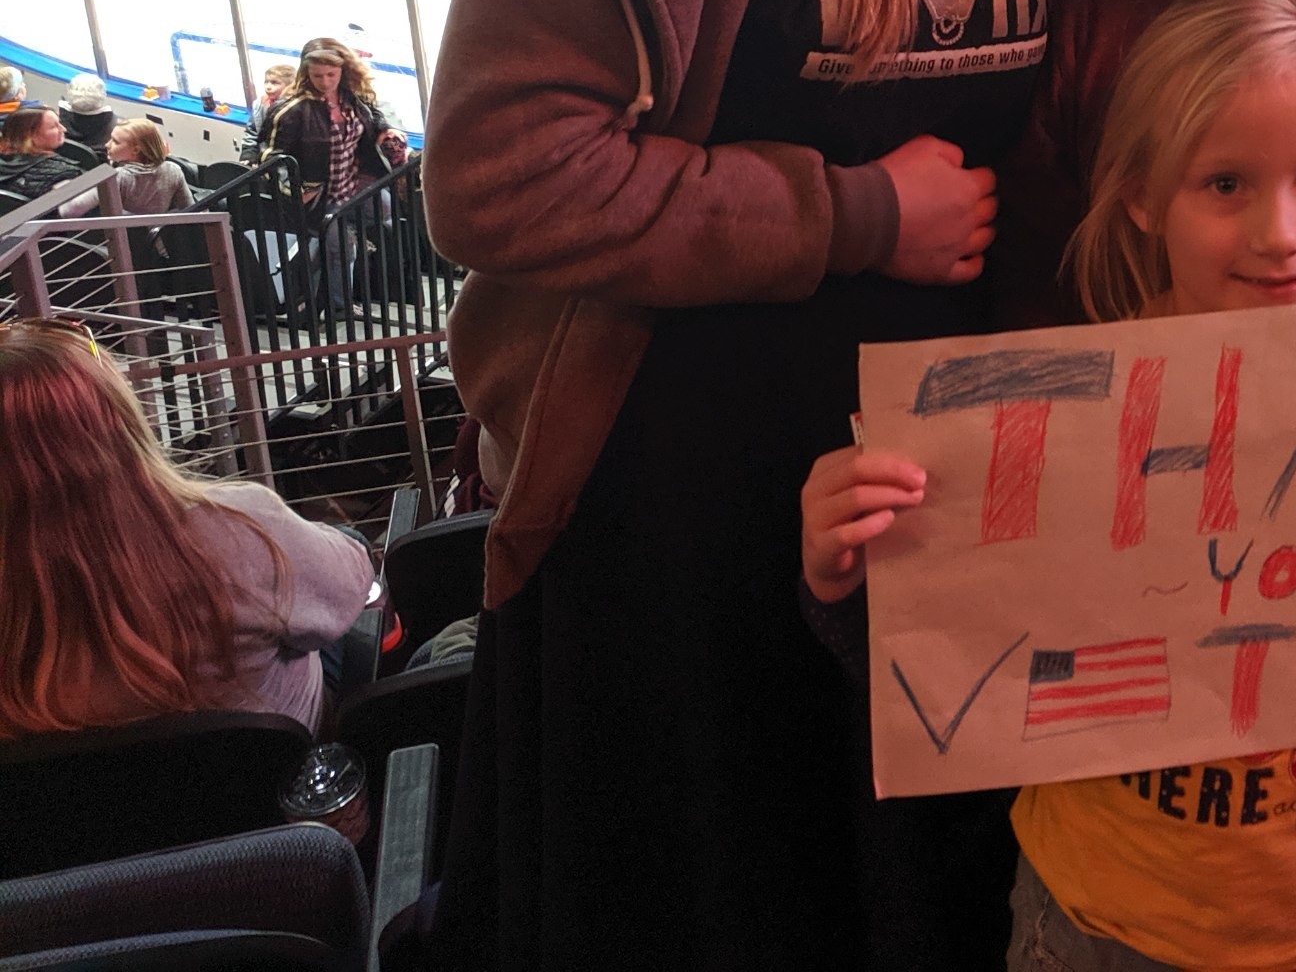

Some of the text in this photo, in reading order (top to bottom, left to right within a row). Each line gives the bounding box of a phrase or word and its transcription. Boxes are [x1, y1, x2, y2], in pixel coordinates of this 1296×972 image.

[939, 57, 954, 70] to
[957, 52, 995, 69] those
[999, 48, 1024, 64] who
